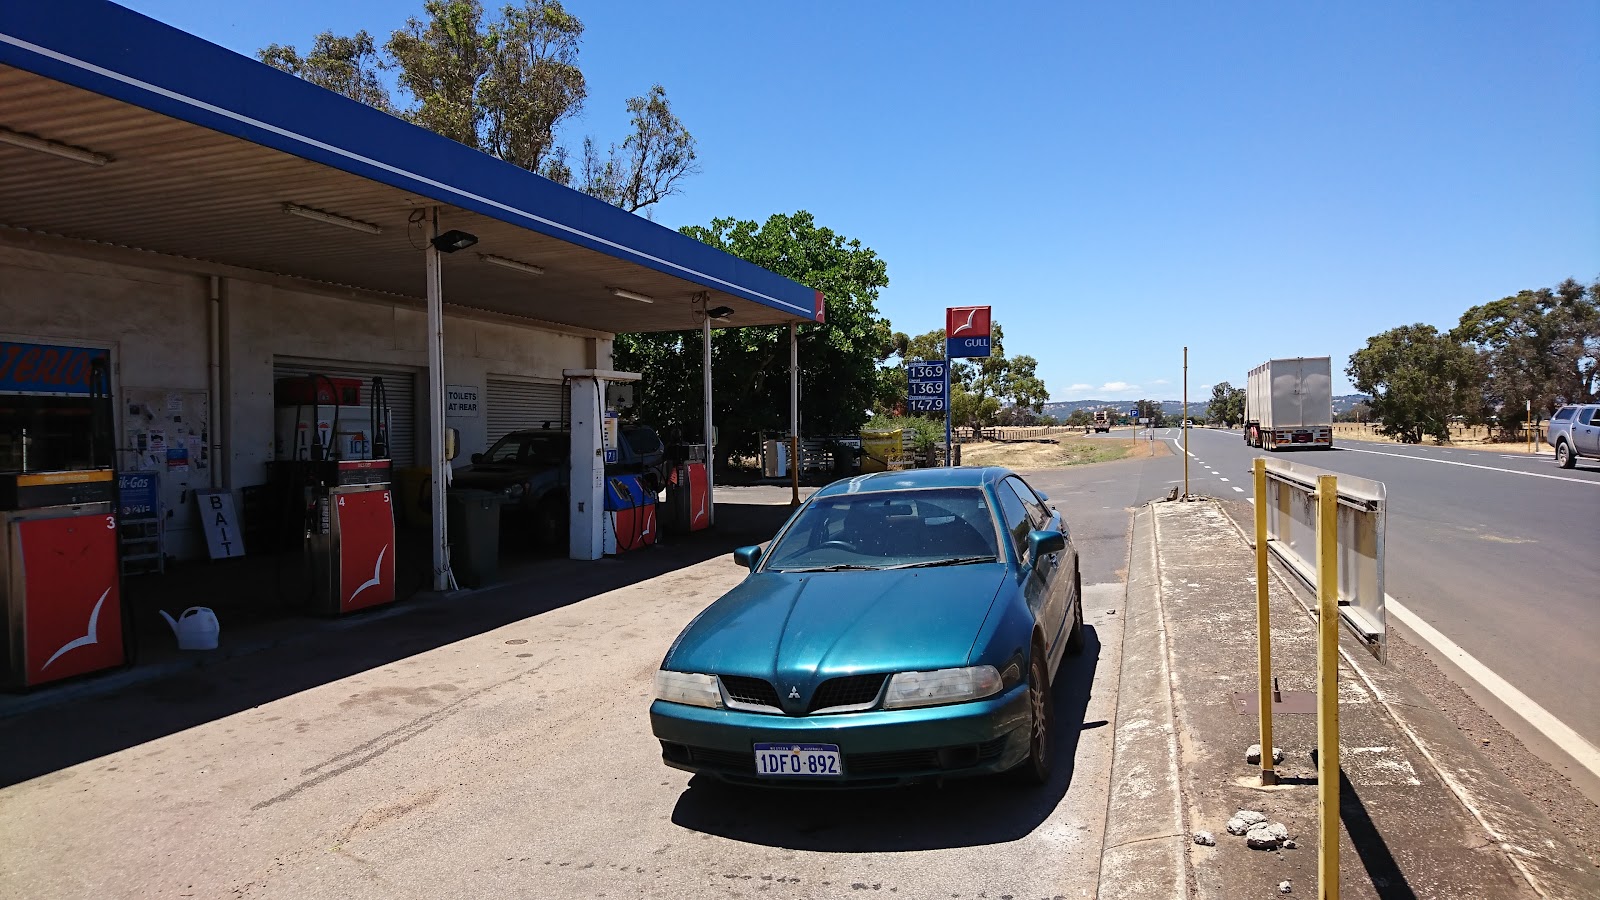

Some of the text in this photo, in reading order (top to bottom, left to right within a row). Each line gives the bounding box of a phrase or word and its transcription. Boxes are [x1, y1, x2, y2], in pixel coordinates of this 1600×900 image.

[964, 338, 988, 347] GULL
[910, 366, 943, 377] 136.9
[911, 383, 943, 394] 136.9
[448, 391, 477, 401] TOILETS
[448, 403, 477, 411] AT REAR
[910, 399, 943, 410] 147.9
[350, 440, 370, 454] ICE
[338, 496, 346, 507] 4
[383, 492, 390, 503] 5
[105, 516, 116, 529] 3
[209, 496, 232, 556] BAIT
